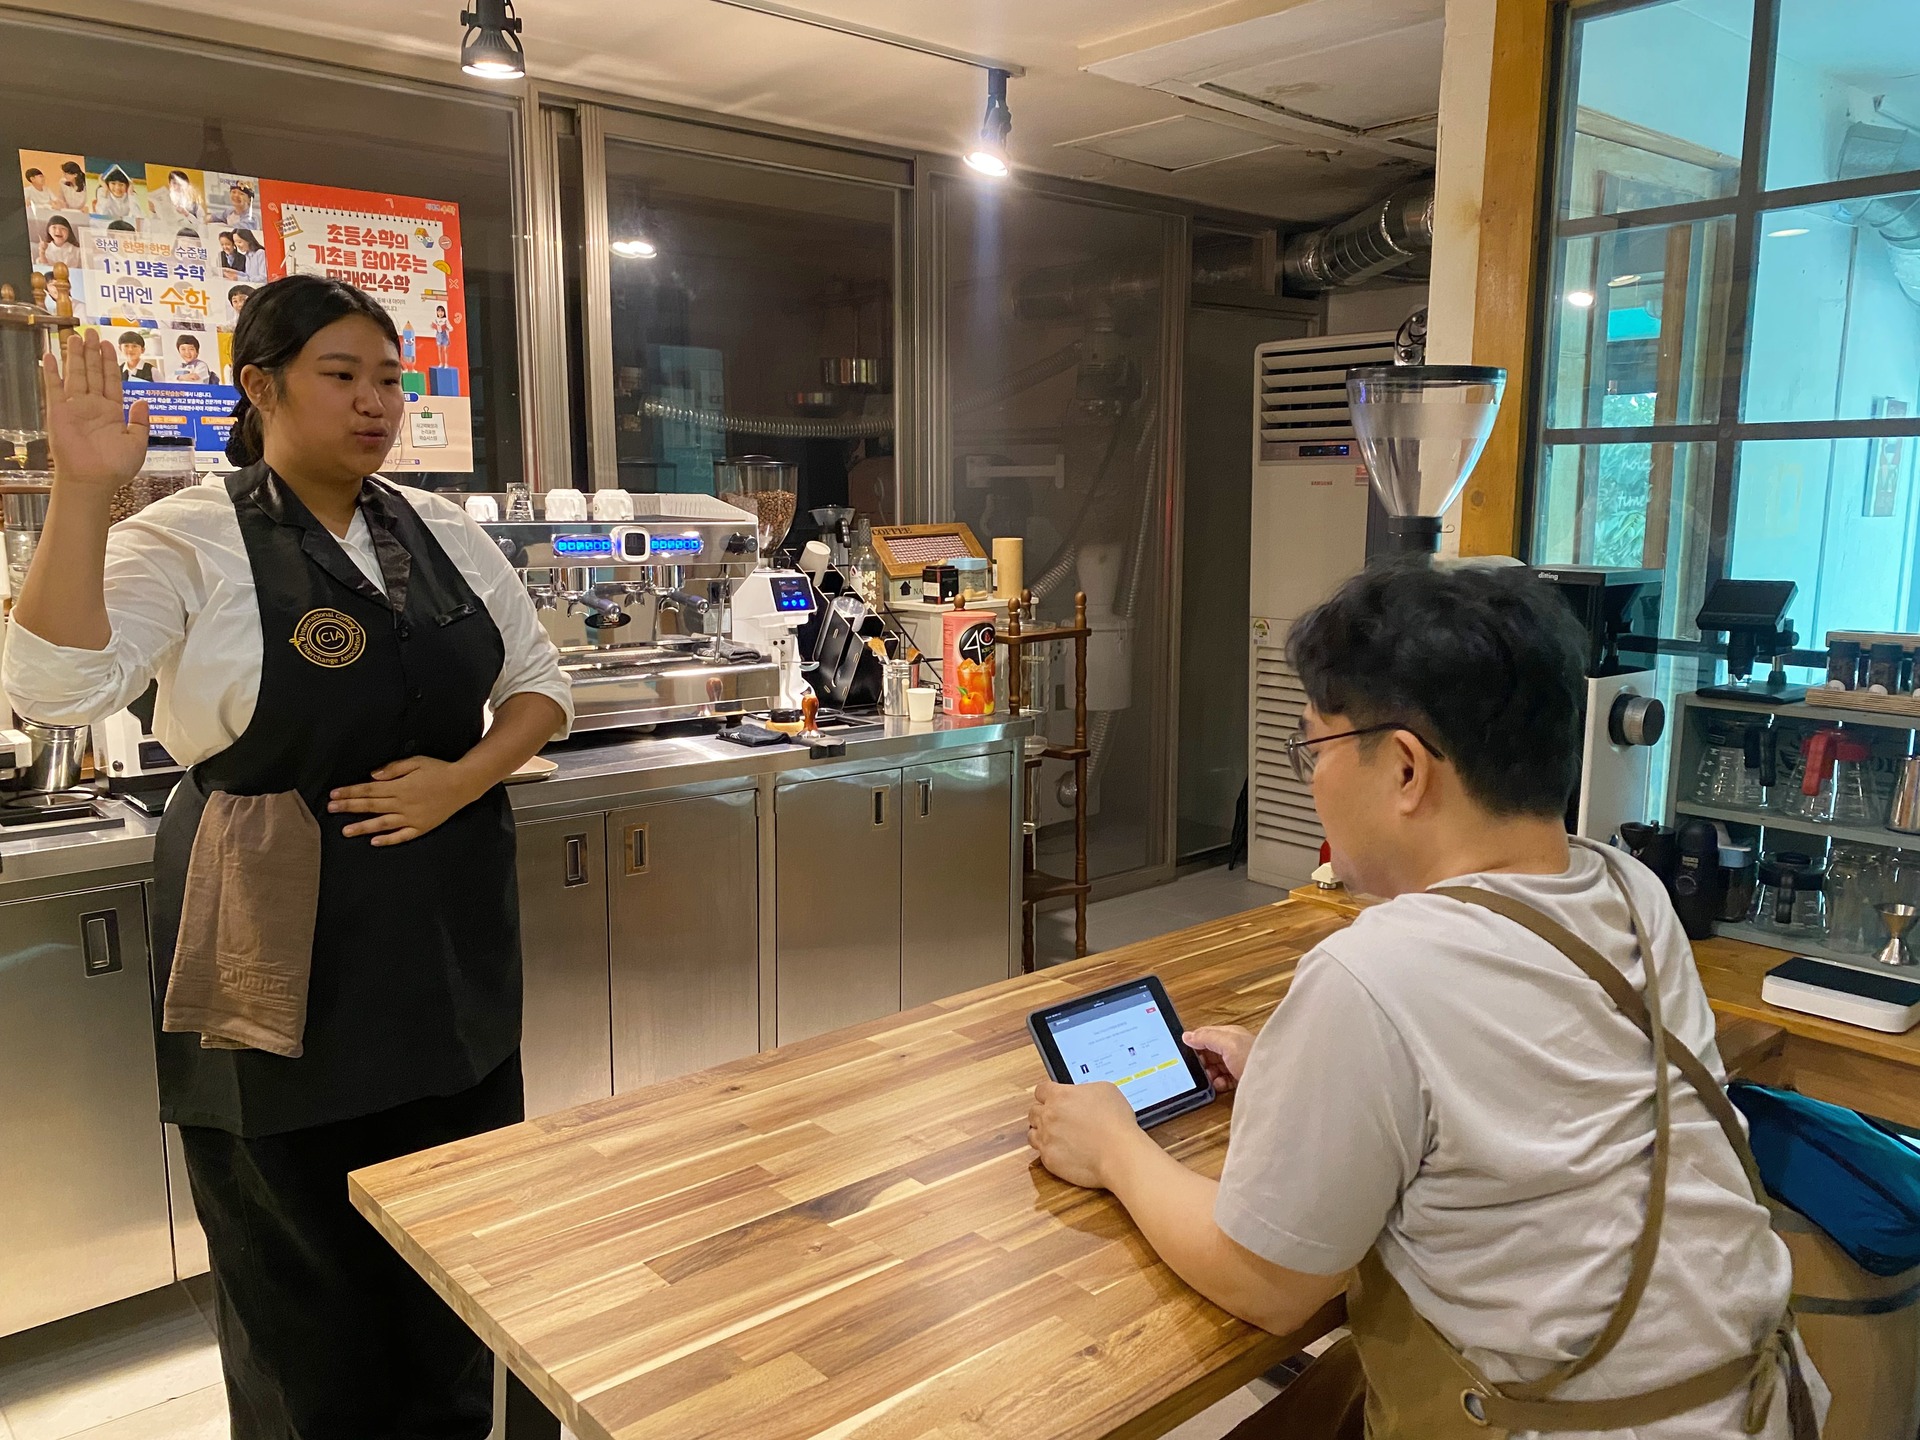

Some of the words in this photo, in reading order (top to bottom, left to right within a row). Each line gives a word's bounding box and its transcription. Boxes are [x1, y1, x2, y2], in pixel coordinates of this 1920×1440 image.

[327, 223, 409, 249] 초등수학의
[96, 238, 118, 253] 학생
[122, 240, 145, 254] 한명
[149, 242, 171, 256] 한명
[175, 245, 207, 260] 수준별
[308, 244, 357, 267] 기초를
[361, 249, 428, 274] 잡아주는
[173, 264, 205, 281] 수학
[100, 285, 153, 304] 미래엔
[159, 287, 210, 316] 수학
[872, 527, 912, 535] COFFEE
[299, 612, 334, 636] International
[335, 613, 356, 628] Coffee
[321, 630, 344, 642] CIA
[301, 643, 339, 664] Interchange
[340, 635, 361, 662] Association
[963, 627, 993, 663] 4C
